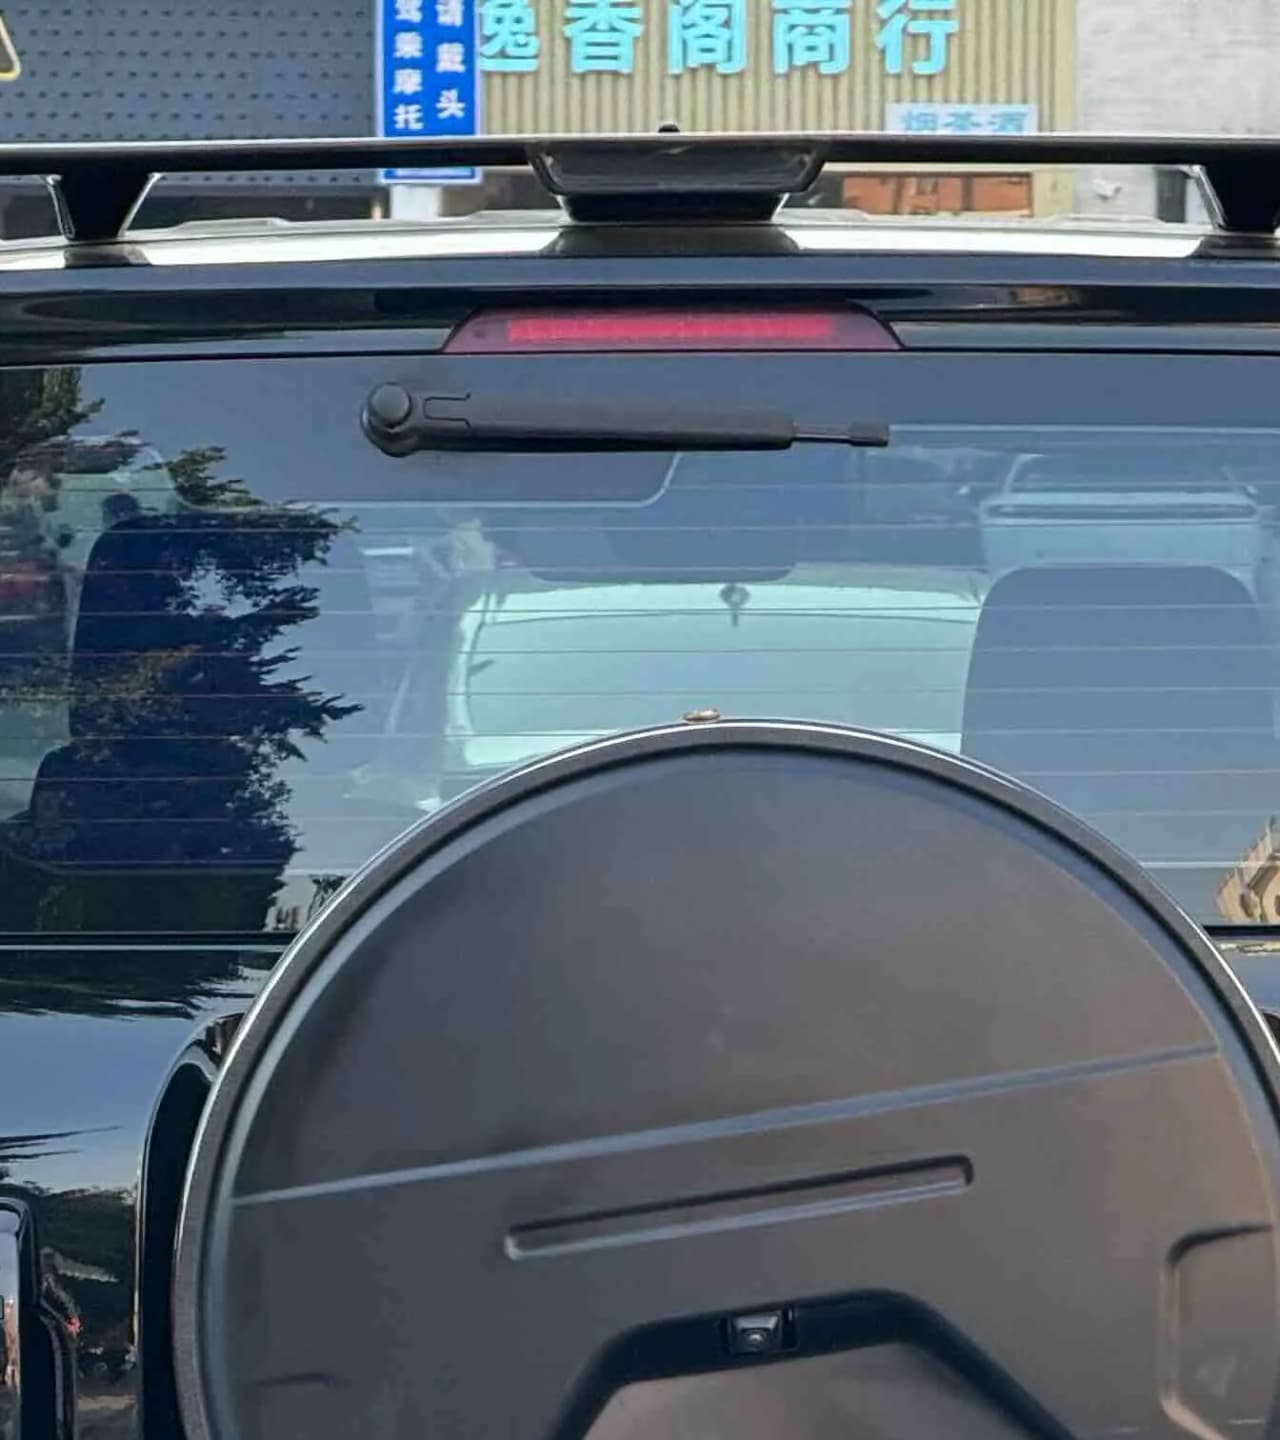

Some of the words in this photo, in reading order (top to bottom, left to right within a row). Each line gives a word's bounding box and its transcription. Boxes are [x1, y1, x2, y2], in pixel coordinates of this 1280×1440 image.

[480, 0, 959, 75] 逸香阁商行
